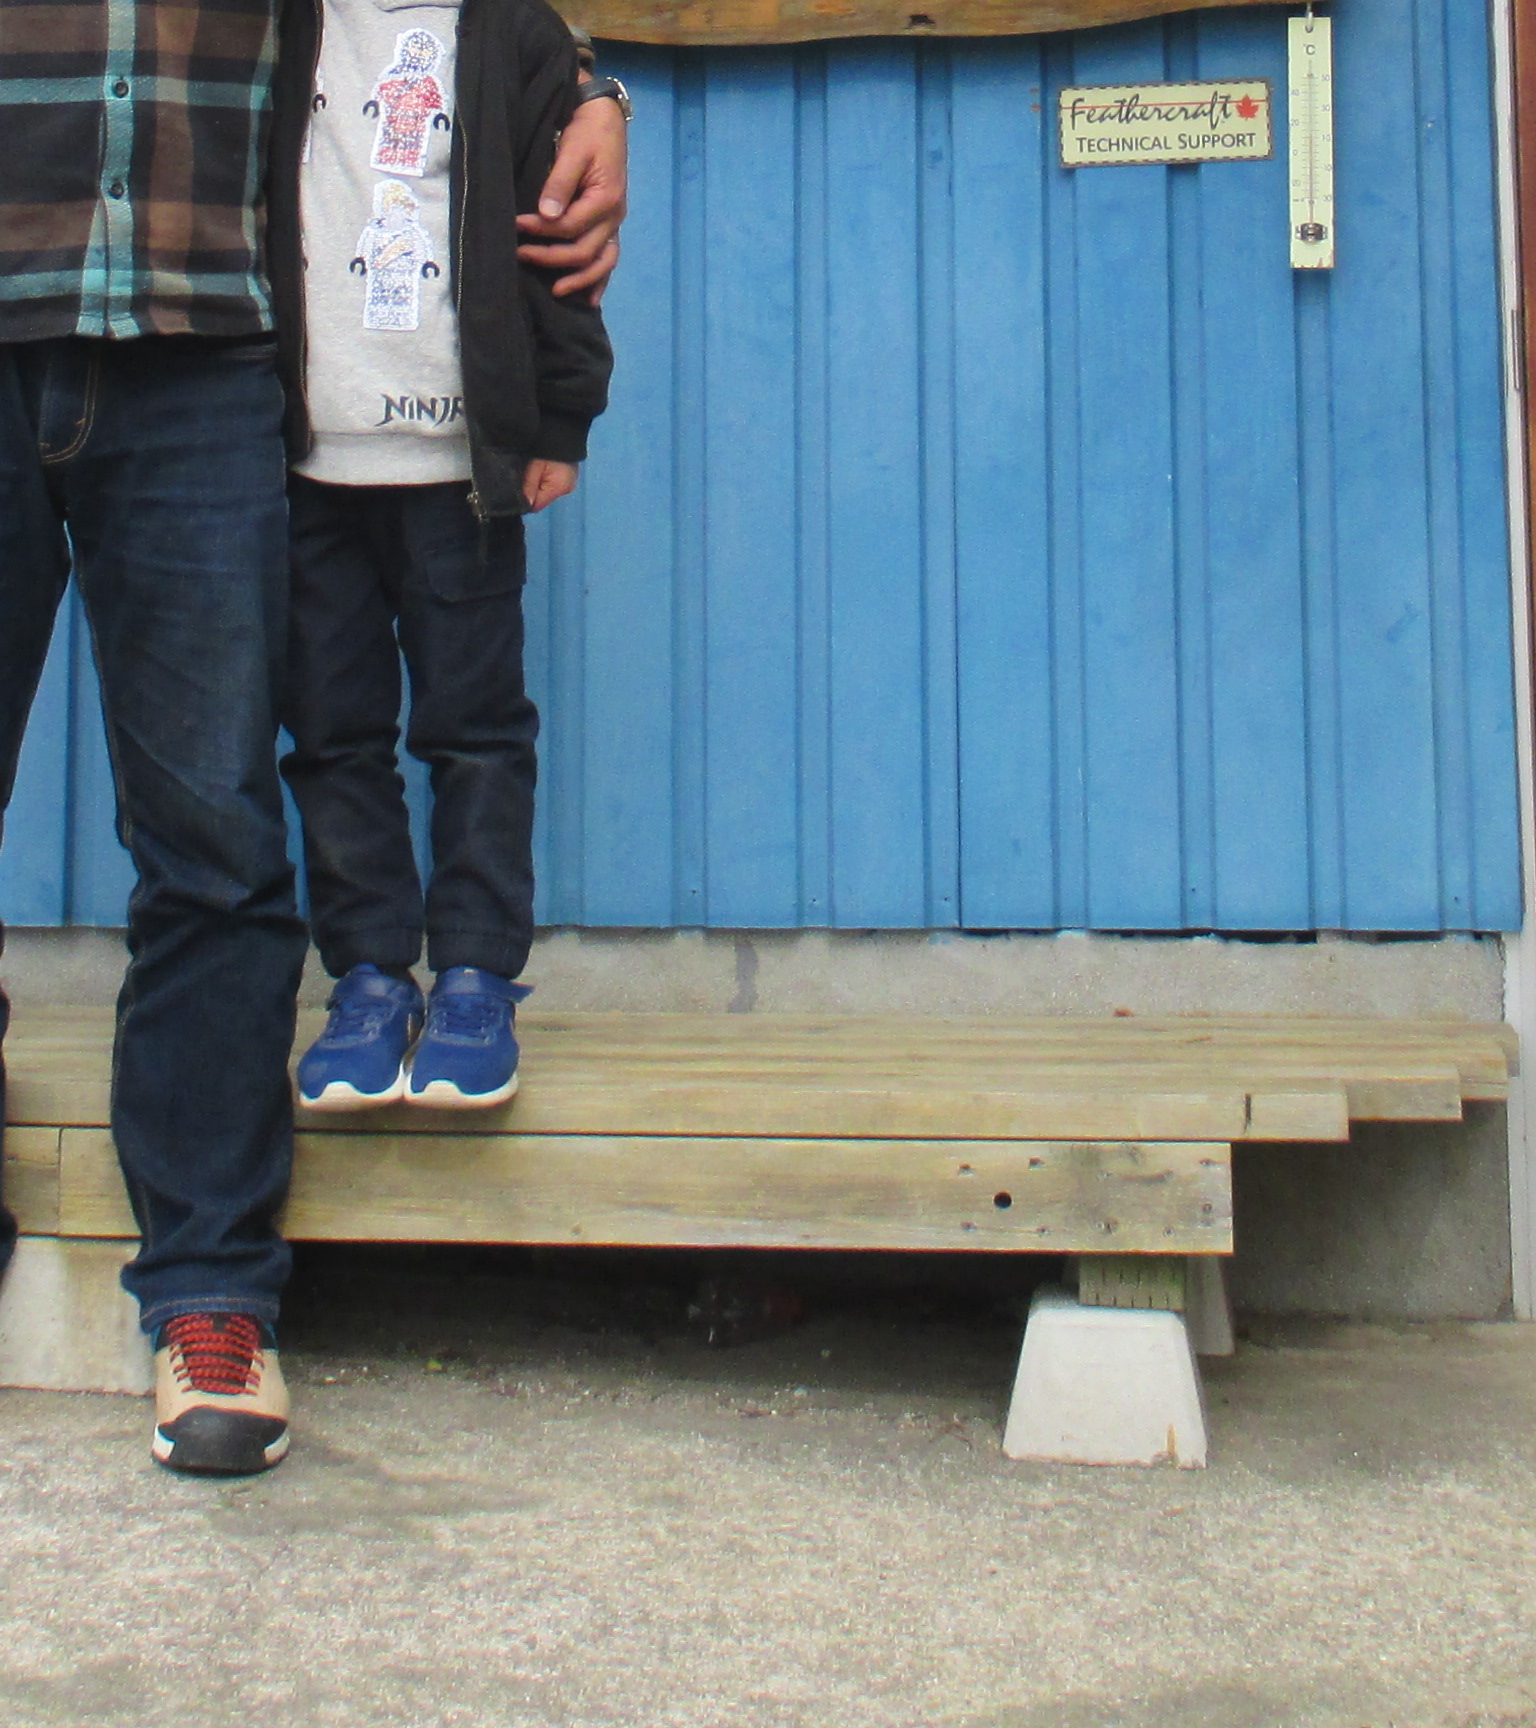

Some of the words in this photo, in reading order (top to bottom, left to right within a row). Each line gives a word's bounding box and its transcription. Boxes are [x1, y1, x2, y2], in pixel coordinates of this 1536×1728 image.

[1070, 91, 1232, 130] Feathercraft
[1076, 136, 1172, 153] TECHNICAL
[1177, 132, 1257, 149] SUPPORT
